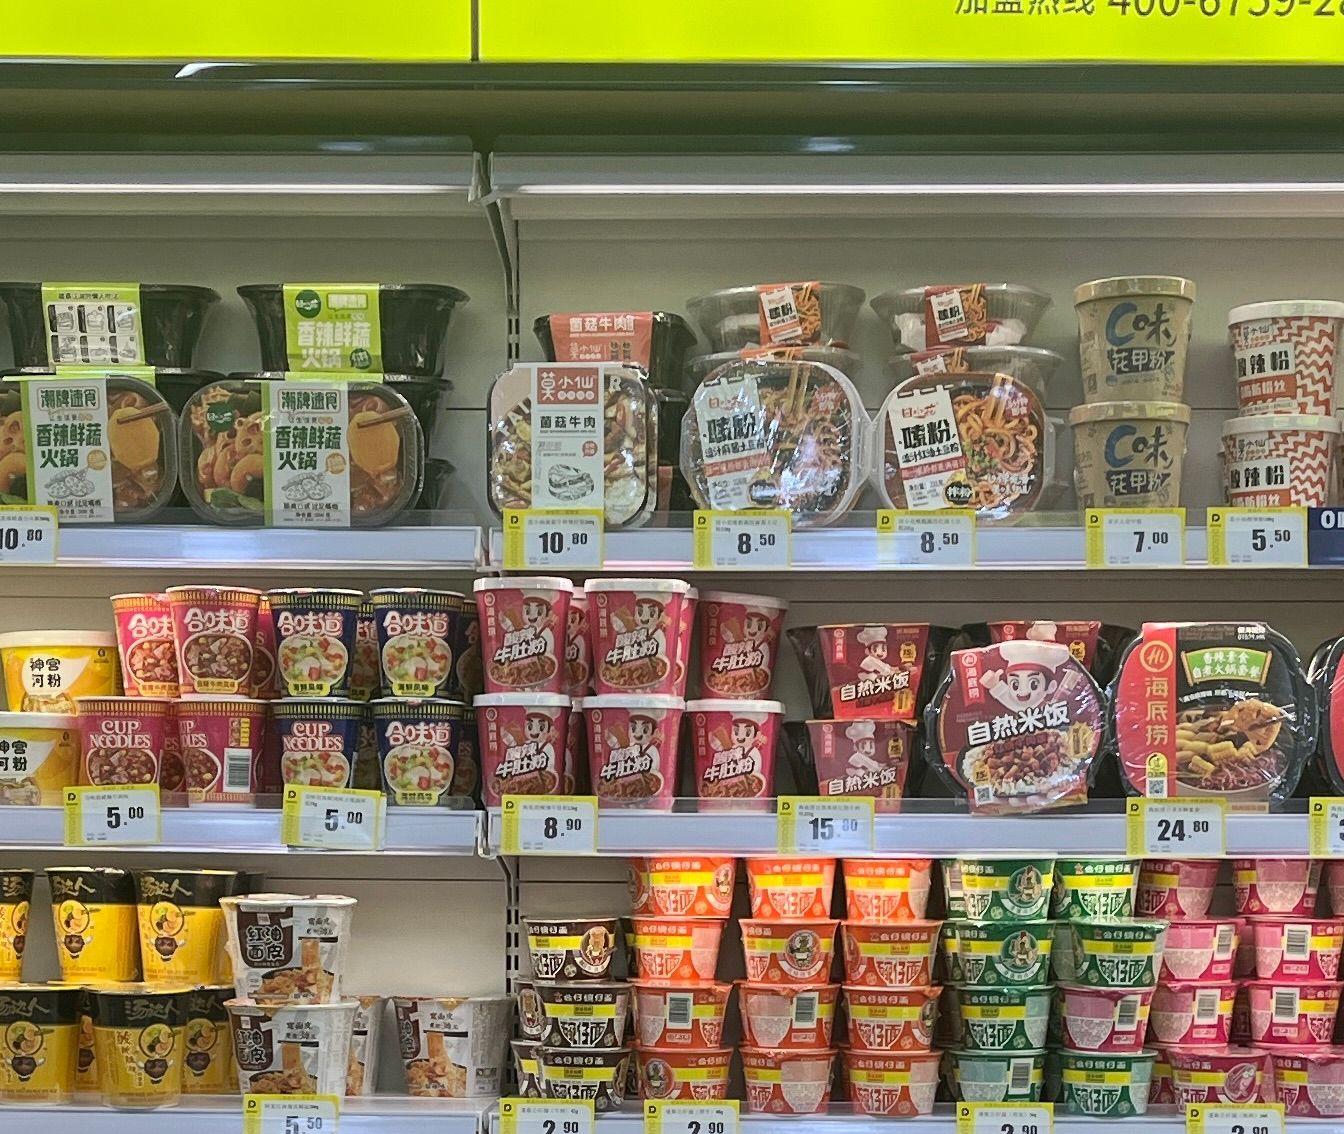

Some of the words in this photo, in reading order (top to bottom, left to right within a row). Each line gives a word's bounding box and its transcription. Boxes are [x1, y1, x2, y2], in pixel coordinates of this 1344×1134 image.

[1111, 351, 1166, 372] 花甲粉
[539, 415, 596, 429] 菌菇牛肉
[36, 423, 103, 447] 香辣鲜蔬
[275, 425, 341, 450] 香辣鲜蔬
[901, 420, 954, 450] 嗦粉
[39, 449, 79, 469] 火锅
[278, 451, 318, 470] 火锅
[1110, 470, 1163, 492] 花甲粉
[737, 532, 776, 554] 8.50
[1133, 530, 1169, 552] 7.00
[1252, 528, 1291, 551] 5.50
[184, 608, 249, 635] 合味道
[278, 611, 344, 637] 合味道
[382, 612, 448, 637] 合味道
[840, 672, 909, 702] 自热米饭
[1144, 676, 1169, 744] 海底捞
[102, 721, 138, 735] CUP
[292, 722, 330, 736] CUP
[386, 722, 452, 746] 合味道
[967, 703, 1069, 747] 自热米饭
[90, 734, 151, 749] NOODLES
[284, 736, 343, 752] NOODLES
[828, 768, 896, 795] 自热米饭
[106, 806, 144, 830] 5.00
[324, 809, 363, 832] 5.00
[544, 817, 582, 838] 8.90
[1157, 820, 1209, 842] 24.80
